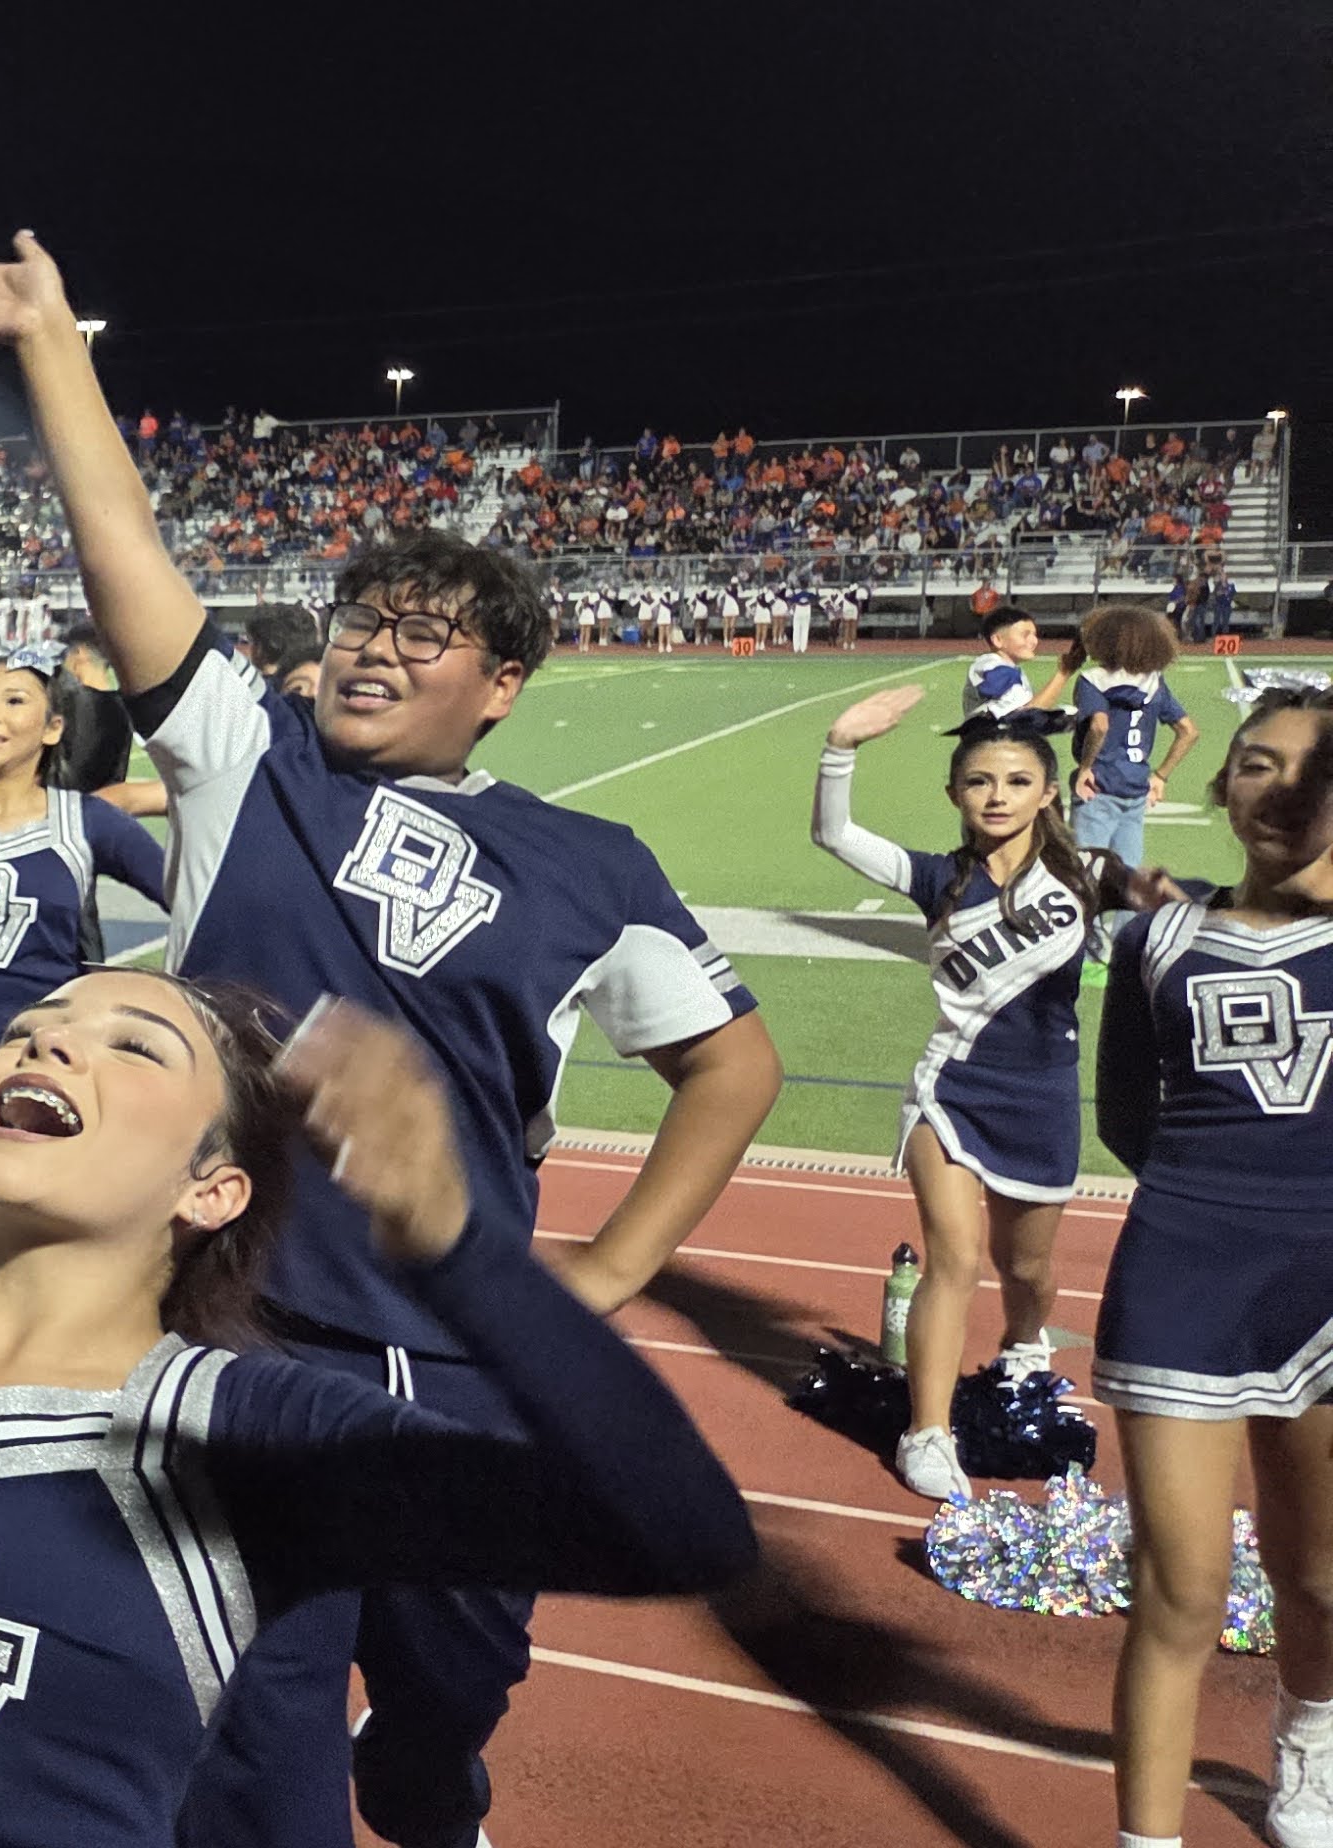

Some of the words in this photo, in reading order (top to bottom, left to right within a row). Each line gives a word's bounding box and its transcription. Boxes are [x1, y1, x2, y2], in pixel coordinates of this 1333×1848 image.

[1217, 639, 1237, 655] 20
[333, 785, 502, 978] DV
[940, 890, 1078, 992] DVMS
[1187, 969, 1333, 1114] DV
